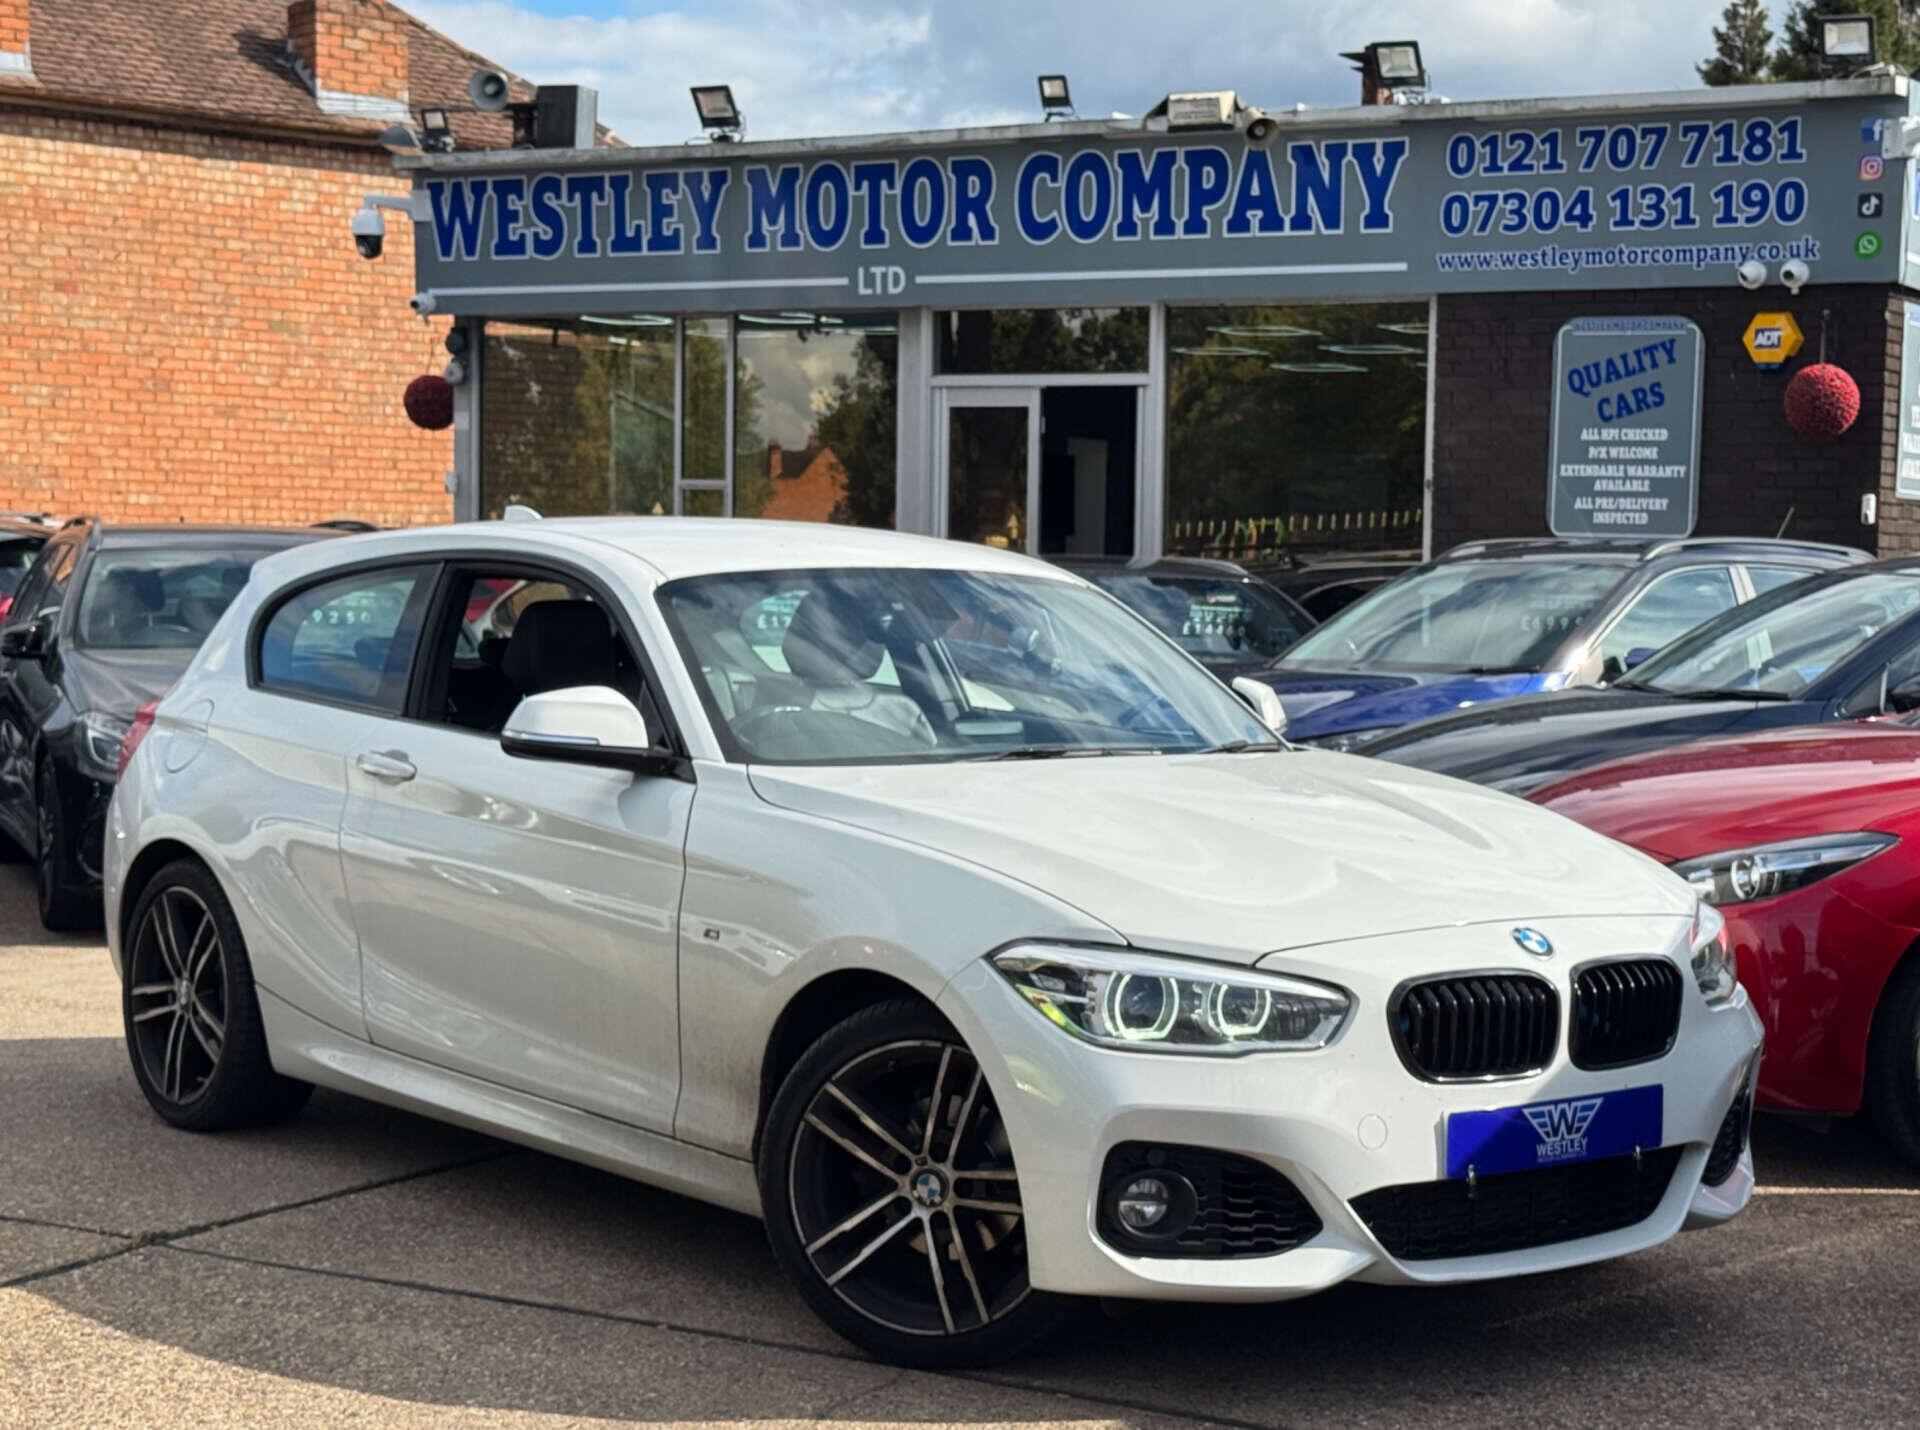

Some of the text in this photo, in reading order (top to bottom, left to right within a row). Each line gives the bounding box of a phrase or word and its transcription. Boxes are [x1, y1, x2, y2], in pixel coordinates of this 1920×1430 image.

[1446, 117, 1807, 178] 0121 707 7181
[426, 137, 1410, 262] WESTLEY MOTOR COMPANY
[1441, 178, 1808, 237] 07304 131 190
[1436, 236, 1821, 272] www.westleymotorcompany.co.uk
[858, 266, 906, 295] LTD
[1754, 330, 1782, 346] ADT
[1568, 339, 1677, 398] QUALITY
[1597, 382, 1666, 423] CARS
[1580, 428, 1600, 440] ALL
[1620, 428, 1669, 441] CHECKED
[1609, 446, 1659, 459] WELCOME
[1626, 465, 1687, 478] WARRANTY
[1593, 480, 1651, 492] AVAILABLE
[1574, 497, 1593, 509] ALL
[1592, 512, 1649, 525] INSPECTED
[1536, 1136, 1588, 1157] WESTLEY
